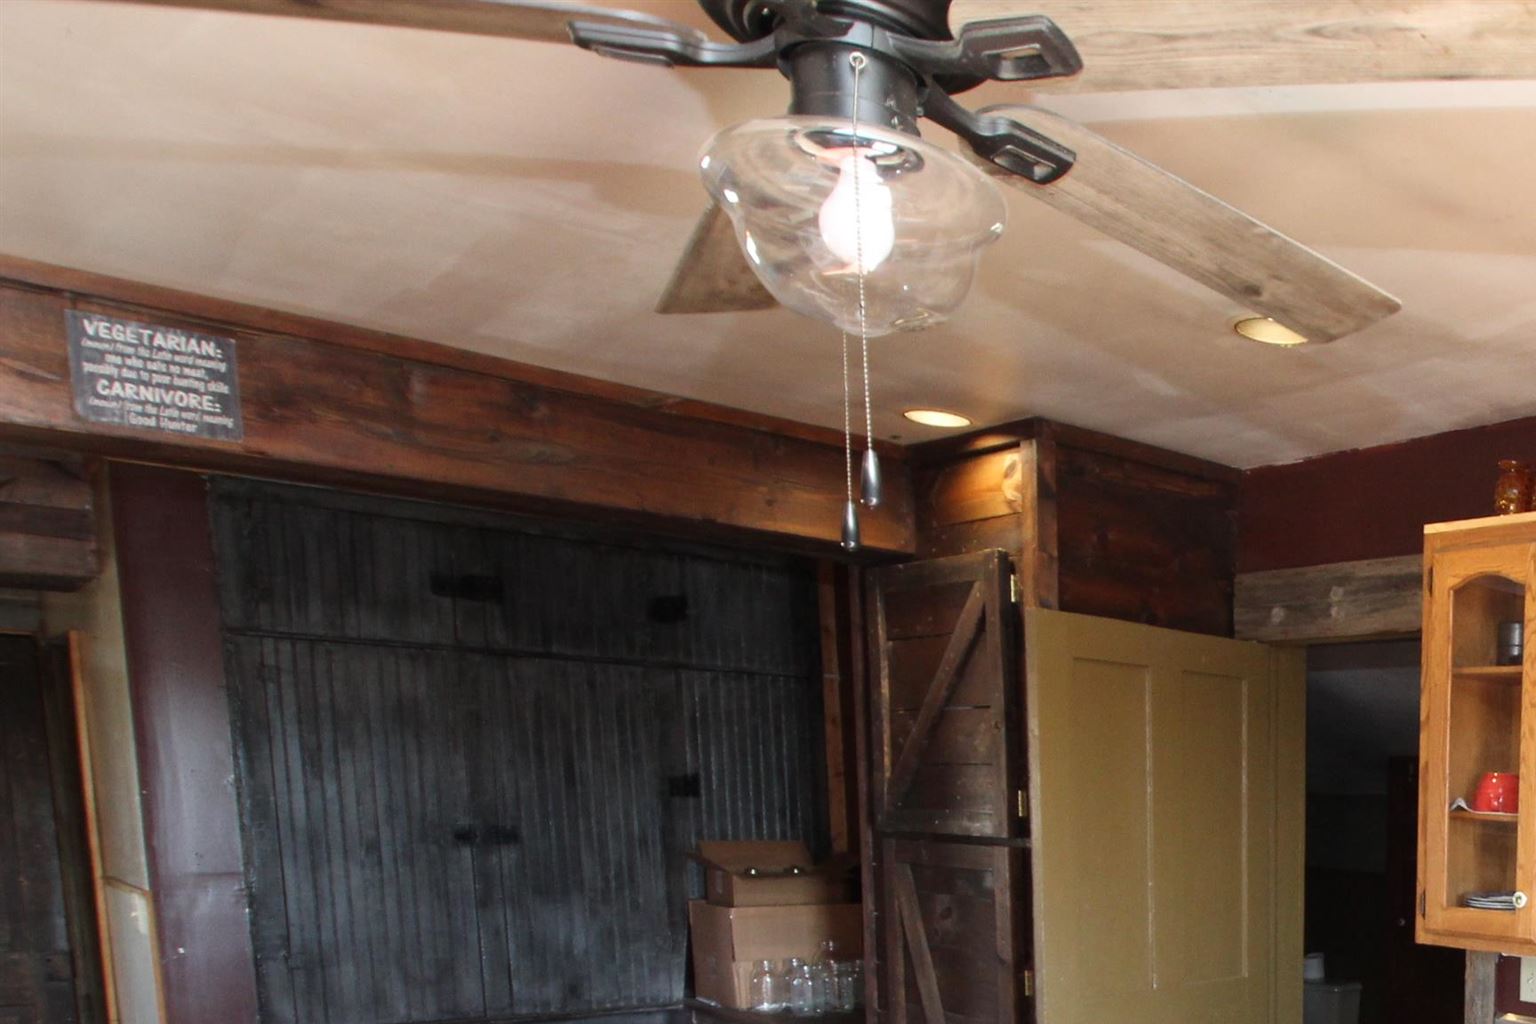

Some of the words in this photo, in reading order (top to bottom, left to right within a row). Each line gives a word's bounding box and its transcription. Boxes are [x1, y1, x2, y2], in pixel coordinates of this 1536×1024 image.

[82, 318, 223, 358] VEGETARIAN:
[137, 346, 152, 358] the
[153, 348, 172, 361] Latin
[96, 378, 222, 412] CARNIVORE:
